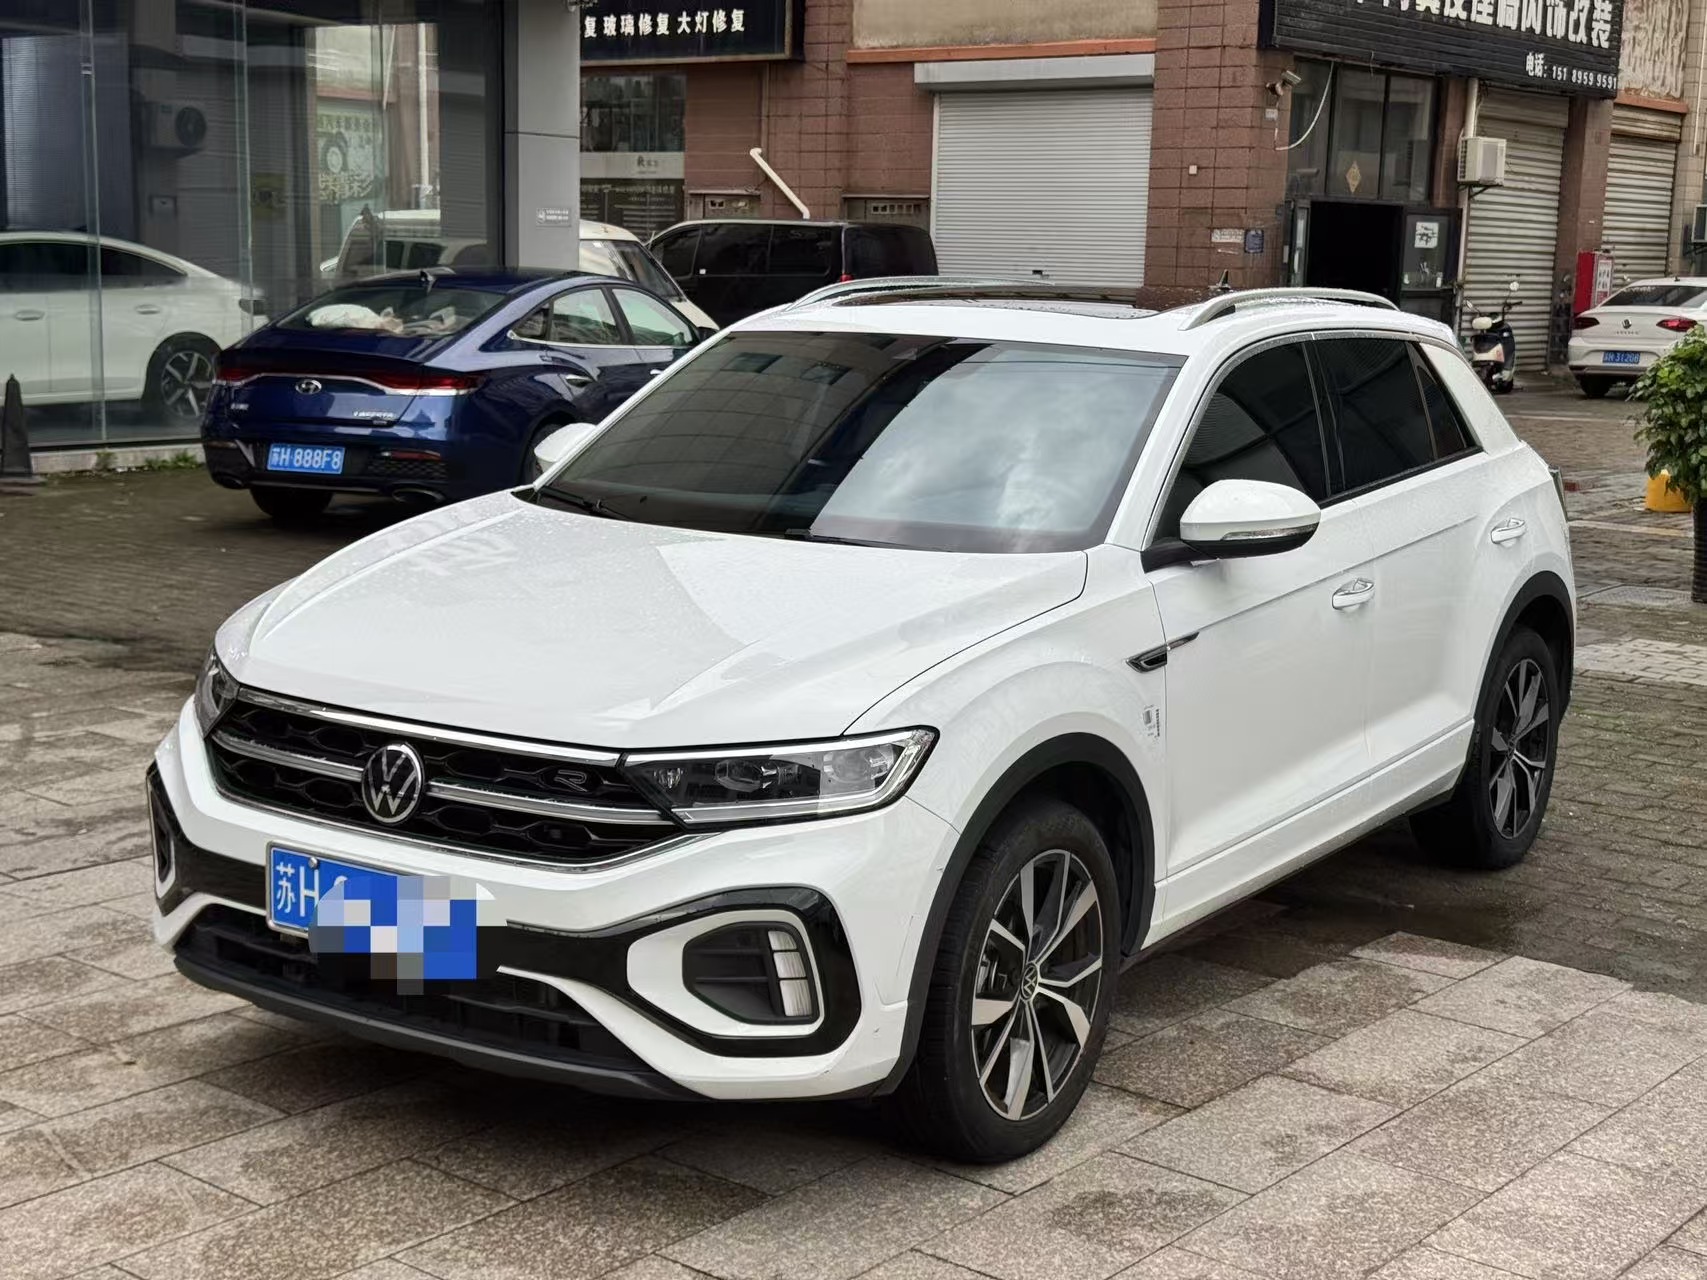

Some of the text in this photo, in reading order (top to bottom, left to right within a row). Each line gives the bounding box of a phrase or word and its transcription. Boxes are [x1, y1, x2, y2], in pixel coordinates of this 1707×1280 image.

[603, 13, 669, 36] 玻璃修复
[677, 9, 744, 34] 大灯修复
[1552, 65, 1567, 80] 151
[1571, 69, 1593, 86] 8959
[1596, 74, 1617, 89] 9591
